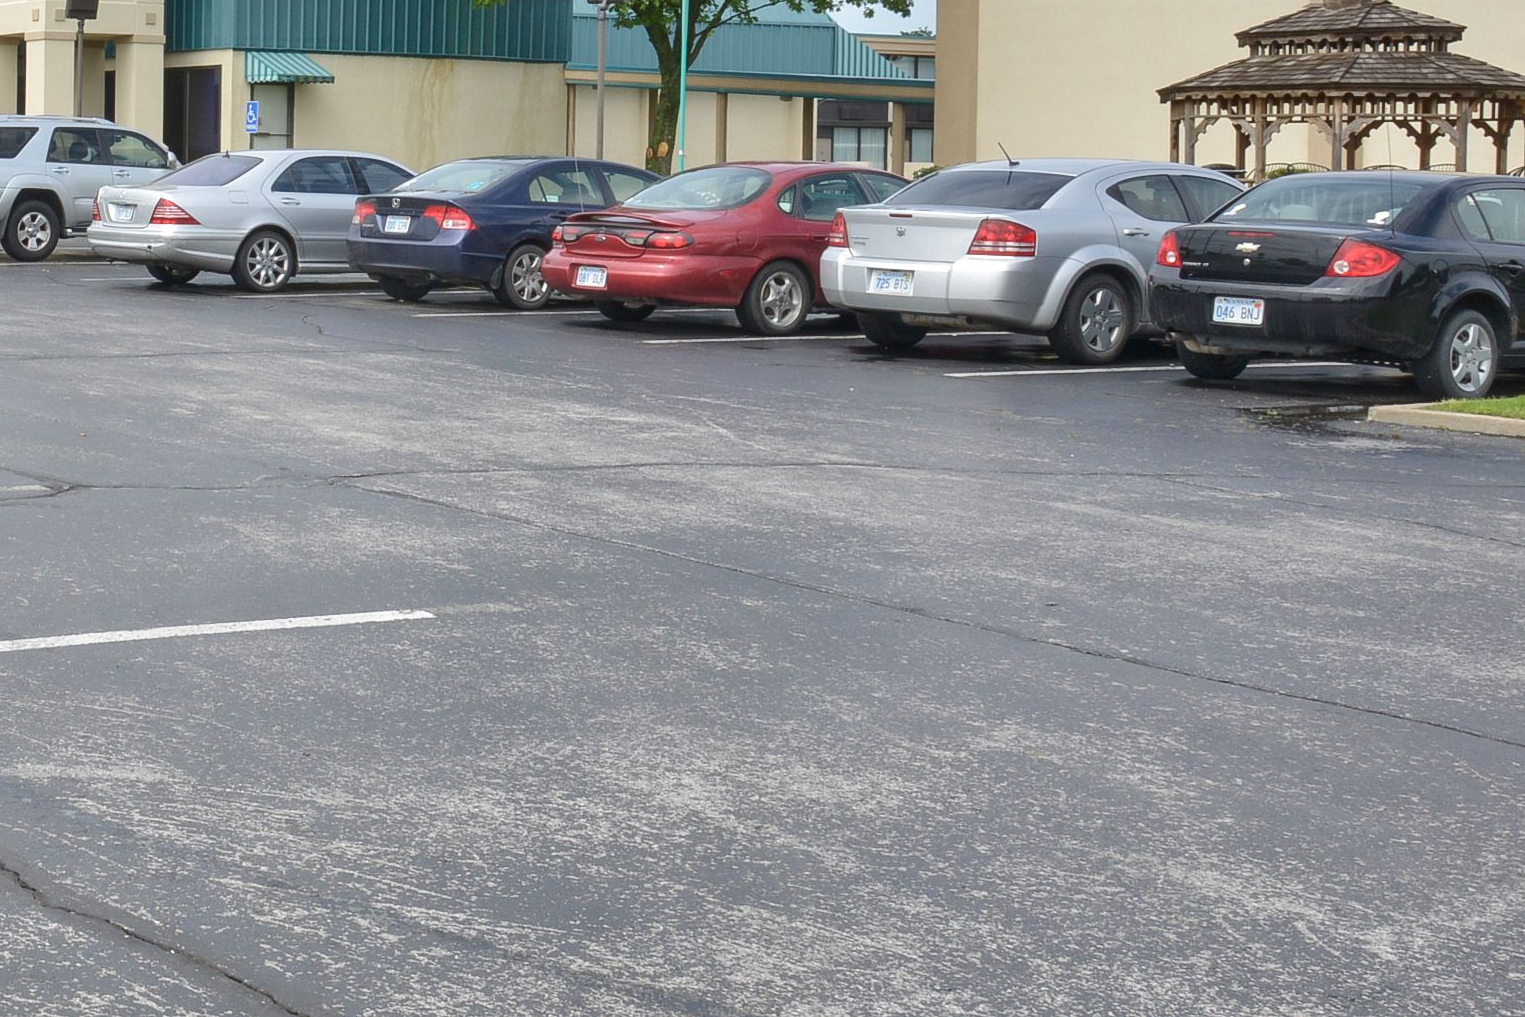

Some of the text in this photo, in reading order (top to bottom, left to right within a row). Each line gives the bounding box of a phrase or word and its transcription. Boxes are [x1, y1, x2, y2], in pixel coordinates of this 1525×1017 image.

[876, 277, 909, 290] 725 BTS
[1216, 305, 1260, 320] 046 BNJ
